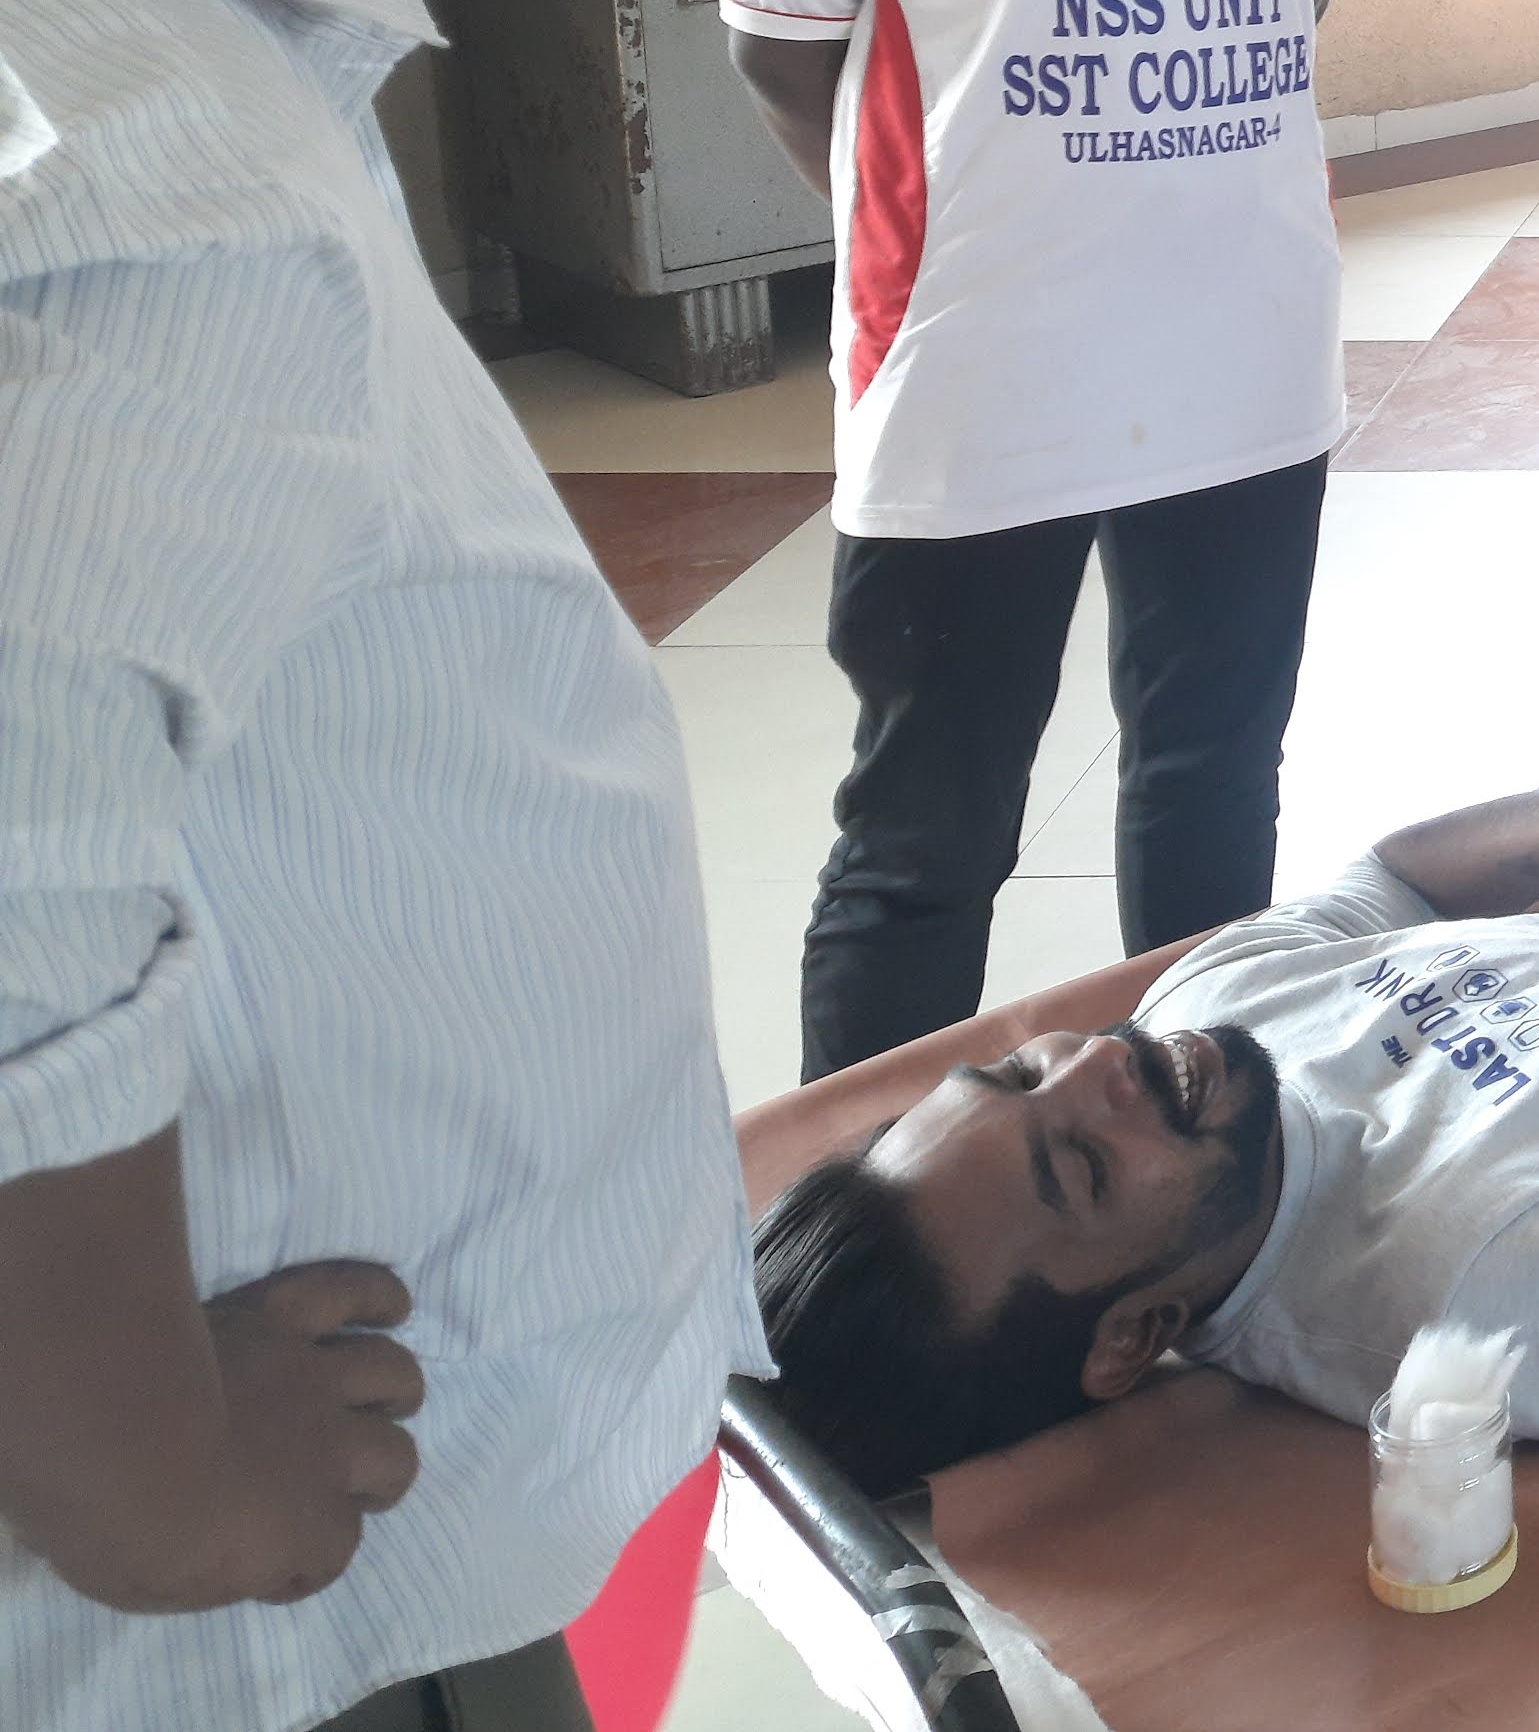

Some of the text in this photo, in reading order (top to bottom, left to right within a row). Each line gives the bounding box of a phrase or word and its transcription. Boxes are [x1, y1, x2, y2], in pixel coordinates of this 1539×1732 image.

[1002, 35, 1310, 117] SST COLLEGE
[1431, 1025, 1532, 1106] LAST
